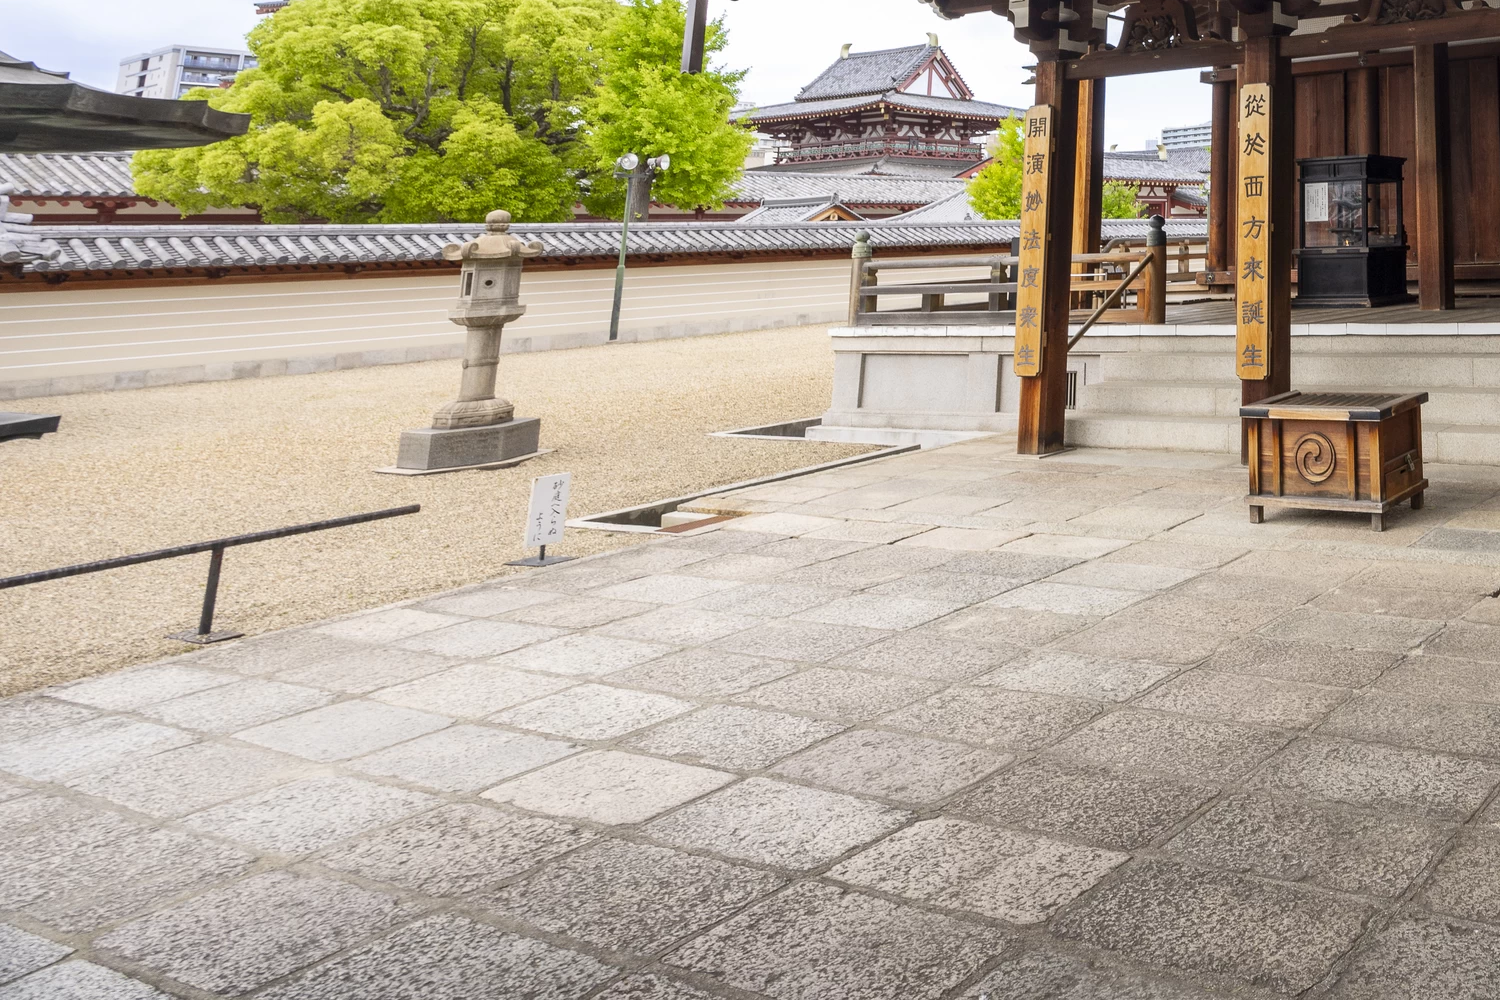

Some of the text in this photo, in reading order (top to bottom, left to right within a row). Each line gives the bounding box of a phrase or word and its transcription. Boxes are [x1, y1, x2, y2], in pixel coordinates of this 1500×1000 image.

[1016, 116, 1047, 368] 開演妙法度衆生
[1241, 93, 1267, 368] 從於西方來誕生
[532, 512, 544, 542] ように
